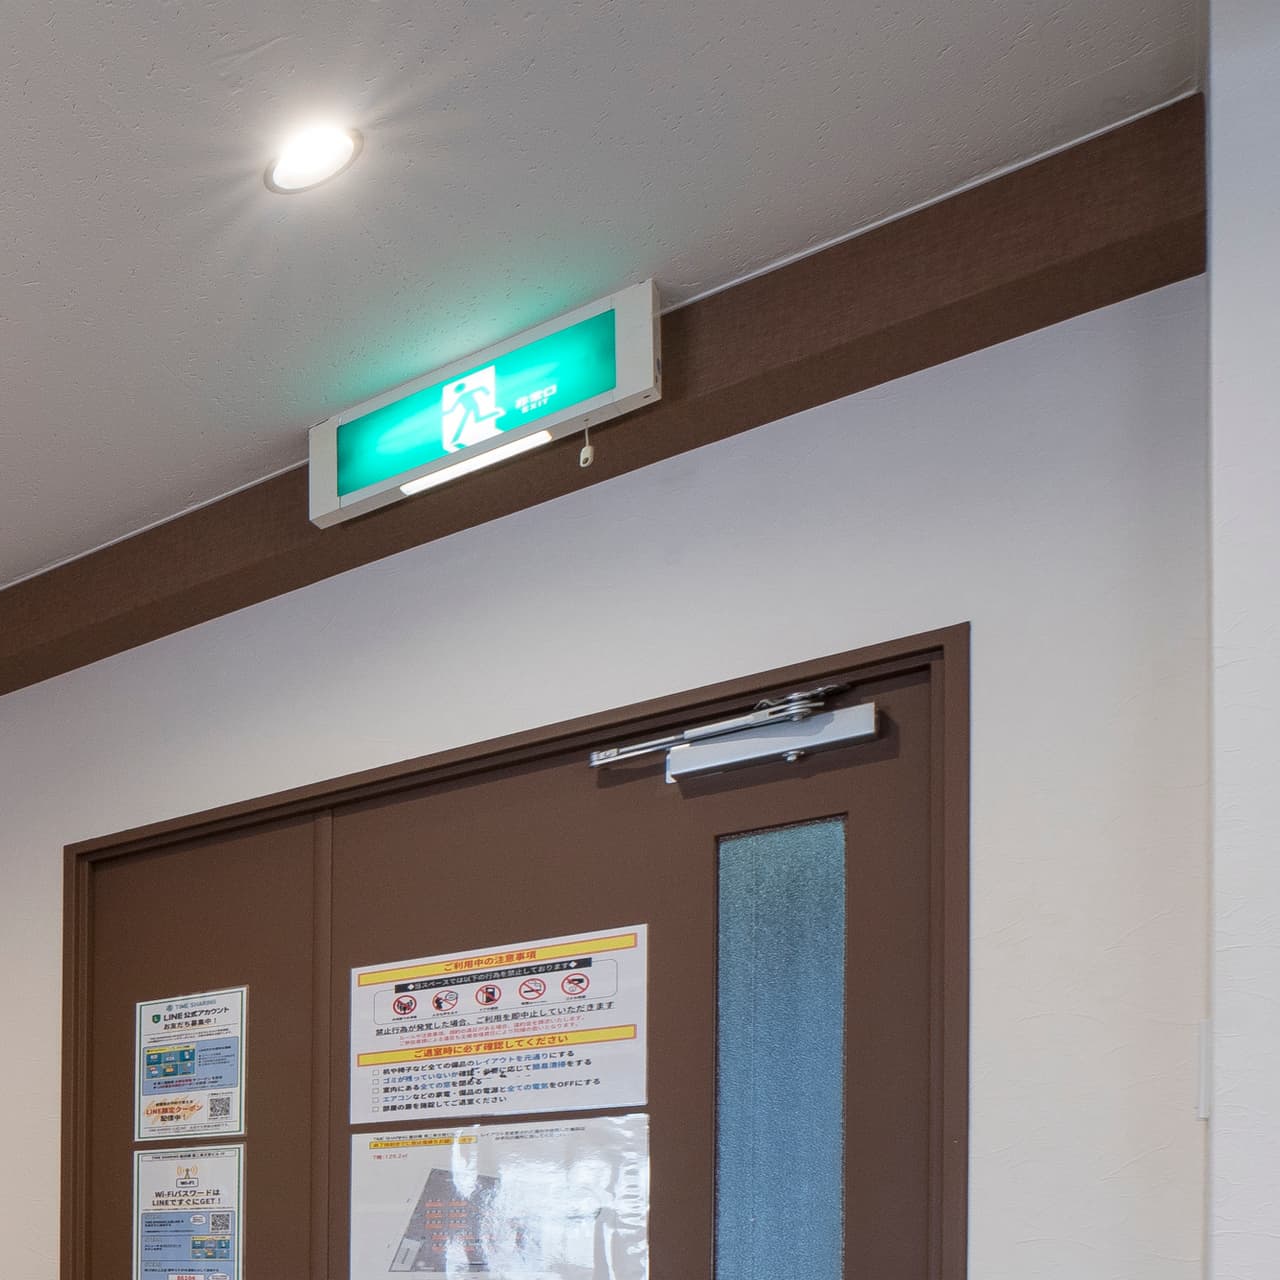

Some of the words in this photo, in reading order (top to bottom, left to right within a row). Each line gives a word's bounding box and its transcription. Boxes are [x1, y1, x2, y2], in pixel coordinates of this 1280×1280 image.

[444, 951, 537, 972] ご利用中の注意事項
[163, 1012, 183, 1022] LINE
[184, 1006, 230, 1019] 公式アカウント
[414, 1035, 569, 1058] ご退室時に必ず確認してください
[154, 1189, 221, 1198] Wi-Fiパスワードは
[152, 1197, 221, 1207] LINEですぐにGET！
